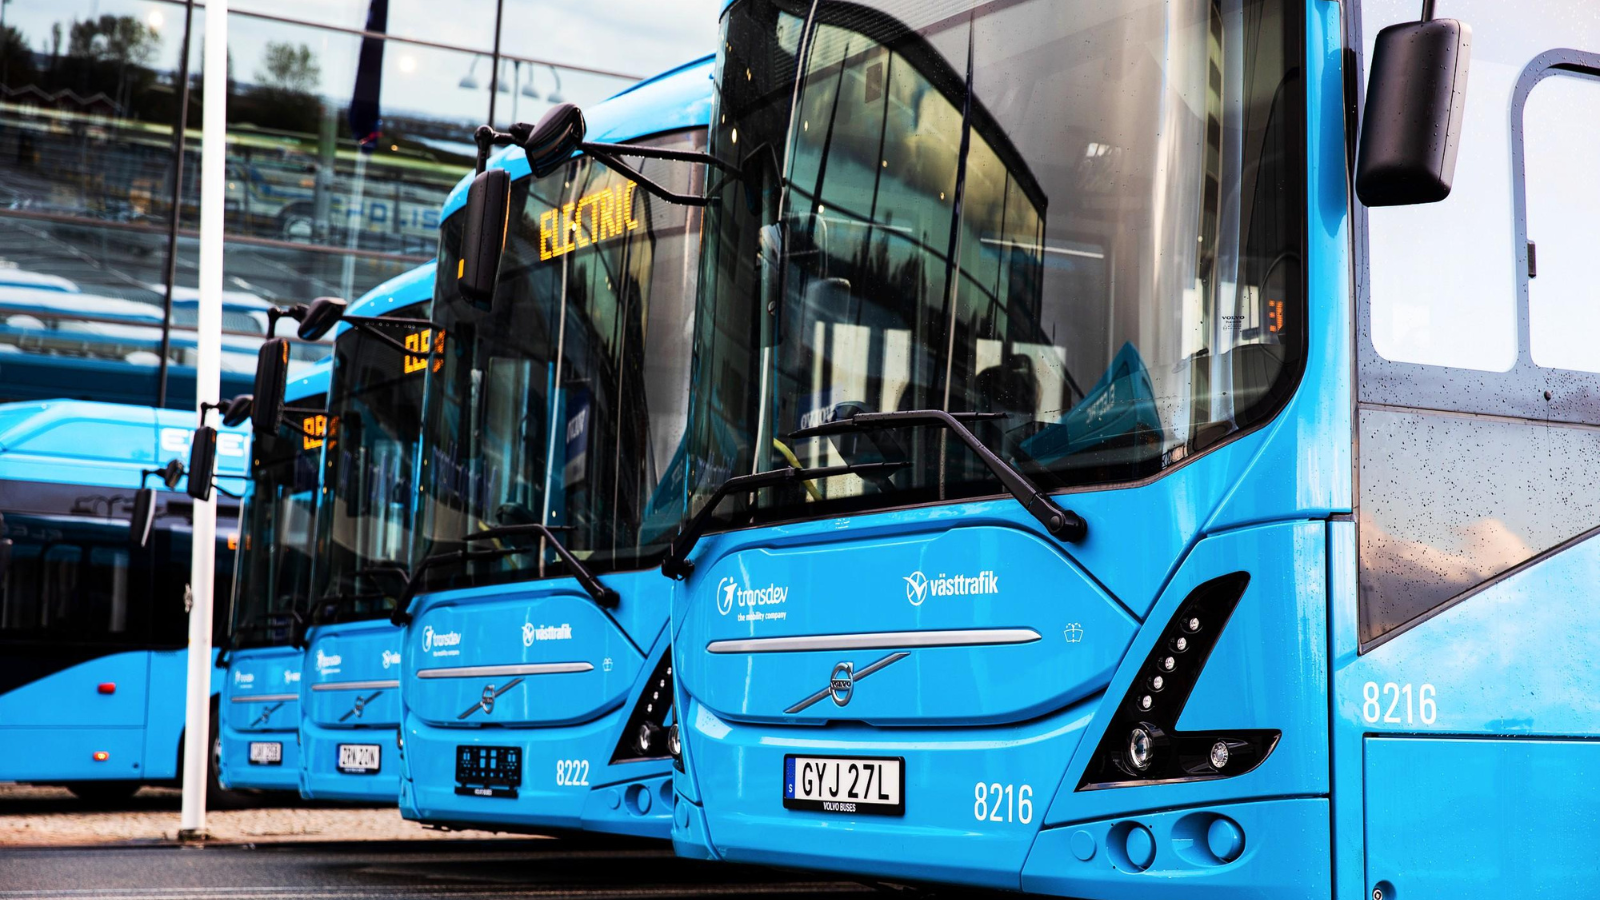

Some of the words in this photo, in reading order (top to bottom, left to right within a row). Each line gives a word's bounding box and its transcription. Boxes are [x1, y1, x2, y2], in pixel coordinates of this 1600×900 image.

[346, 200, 441, 231] POIS
[540, 180, 639, 261] ELECTRIC
[737, 583, 788, 607] transdev
[929, 570, 999, 597] västtrafik
[737, 613, 746, 622] the
[830, 681, 852, 689] VOLVO
[1363, 681, 1437, 725] 8216
[556, 759, 590, 786] 8222
[788, 783, 793, 793] S
[802, 762, 840, 798] GYJ
[847, 763, 890, 801] 27L
[823, 801, 840, 811] VOLVO
[840, 802, 857, 812] BUSES
[974, 781, 1033, 825] 8216
